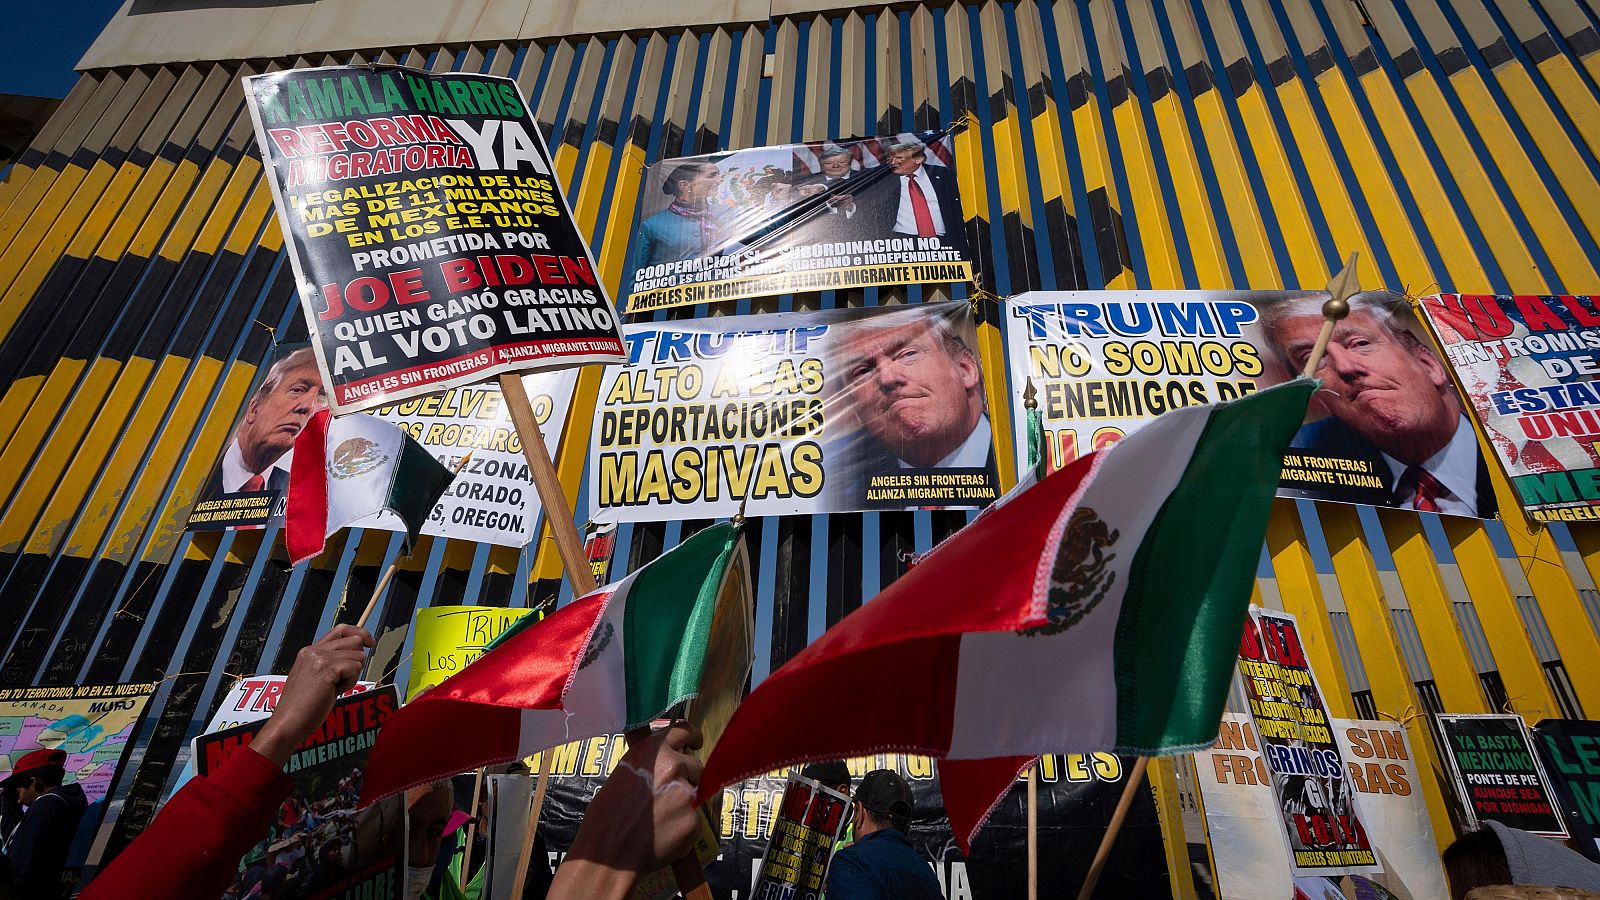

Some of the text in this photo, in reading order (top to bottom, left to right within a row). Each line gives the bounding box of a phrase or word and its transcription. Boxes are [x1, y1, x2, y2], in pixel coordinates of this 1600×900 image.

[265, 74, 524, 124] KAMALA HARRIS
[267, 115, 463, 158] REFORMA
[447, 119, 551, 175] YA
[288, 144, 474, 186] MIGRATORIA
[481, 176, 511, 188] DE
[516, 177, 553, 191] LOS
[301, 188, 555, 224] MAS DE 11 MILLONES
[307, 201, 560, 238] DE MEXICANOS
[346, 215, 539, 248] EN LOS E.E. U.U.
[351, 232, 550, 272] PROMETIDA POR
[635, 254, 741, 282] COOPERACION
[918, 238, 953, 251] NO...
[318, 254, 596, 322] JOE BIDEN
[632, 289, 682, 310] ANGELES
[685, 287, 705, 302] SIN
[708, 280, 779, 299] FRONTERAS
[844, 267, 910, 284] MIGRANTE
[912, 265, 966, 281] TIJUANA
[633, 276, 677, 293] MEXICO
[680, 273, 693, 285] ES
[695, 270, 714, 282] UN
[864, 251, 962, 265] INDEPENDIENTE
[333, 287, 598, 342] QUIEN GANÓ GRACIAS
[1013, 300, 1260, 342] TRUMP
[1421, 293, 1515, 345] NO
[1511, 294, 1569, 332] A
[333, 307, 613, 376] AL VOTO LATINO
[1028, 340, 1264, 379] NO SOMOS
[1450, 329, 1600, 367] INTROMIS
[400, 370, 422, 386] SIN
[423, 354, 489, 379] FRONTERAS
[490, 348, 496, 365] /
[499, 346, 541, 361] ALIANZA
[542, 341, 588, 354] MIGRANTE
[588, 341, 621, 352] TIJUANA
[605, 363, 703, 406] ALTO
[1045, 379, 1210, 422] ENEMIGOS
[1489, 381, 1600, 417] ESTA
[424, 422, 546, 455] ROBARO
[600, 399, 825, 447] DEPORTACIONES
[1517, 410, 1600, 441] UNI
[599, 441, 825, 508] MASIVAS
[871, 475, 912, 487] ANGELES
[913, 475, 930, 486] SIN
[931, 474, 985, 486] FRONTERAS
[1280, 468, 1384, 489] MIGRANTE TIJUANA
[1283, 455, 1302, 467] SIN
[1303, 456, 1368, 473] FRONTERAS
[195, 500, 222, 512] ANGELES
[221, 499, 233, 509] SIN
[231, 497, 268, 509] FRONTERAS
[867, 487, 996, 500] ALIANZA MIGRANTE TIJUANA
[189, 508, 269, 523] ALIANZA MIGRANTE TIJUANA
[451, 507, 526, 534] OREGON.
[428, 652, 457, 671] LOS
[11, 700, 65, 713] CANADA
[12, 688, 25, 699] TU
[24, 686, 73, 699] TERRITORIO,
[75, 686, 90, 697] NO
[89, 686, 103, 697] EN
[101, 685, 114, 696] EL
[1253, 680, 1269, 696] DE
[1268, 681, 1287, 699] LOS
[1302, 708, 1325, 724] SOLO
[1346, 728, 1410, 761] SIN
[1455, 735, 1522, 750] YA BASTA
[1265, 743, 1342, 779] GRINOS
[1458, 752, 1533, 771] MEXICANO
[1466, 774, 1539, 786] PONTE DE PIE
[1474, 787, 1541, 800] AUNQUE SEA
[1476, 801, 1551, 814] POR DIGNIDAD
[1295, 851, 1326, 866] ANGELES
[1325, 851, 1341, 866] SIN
